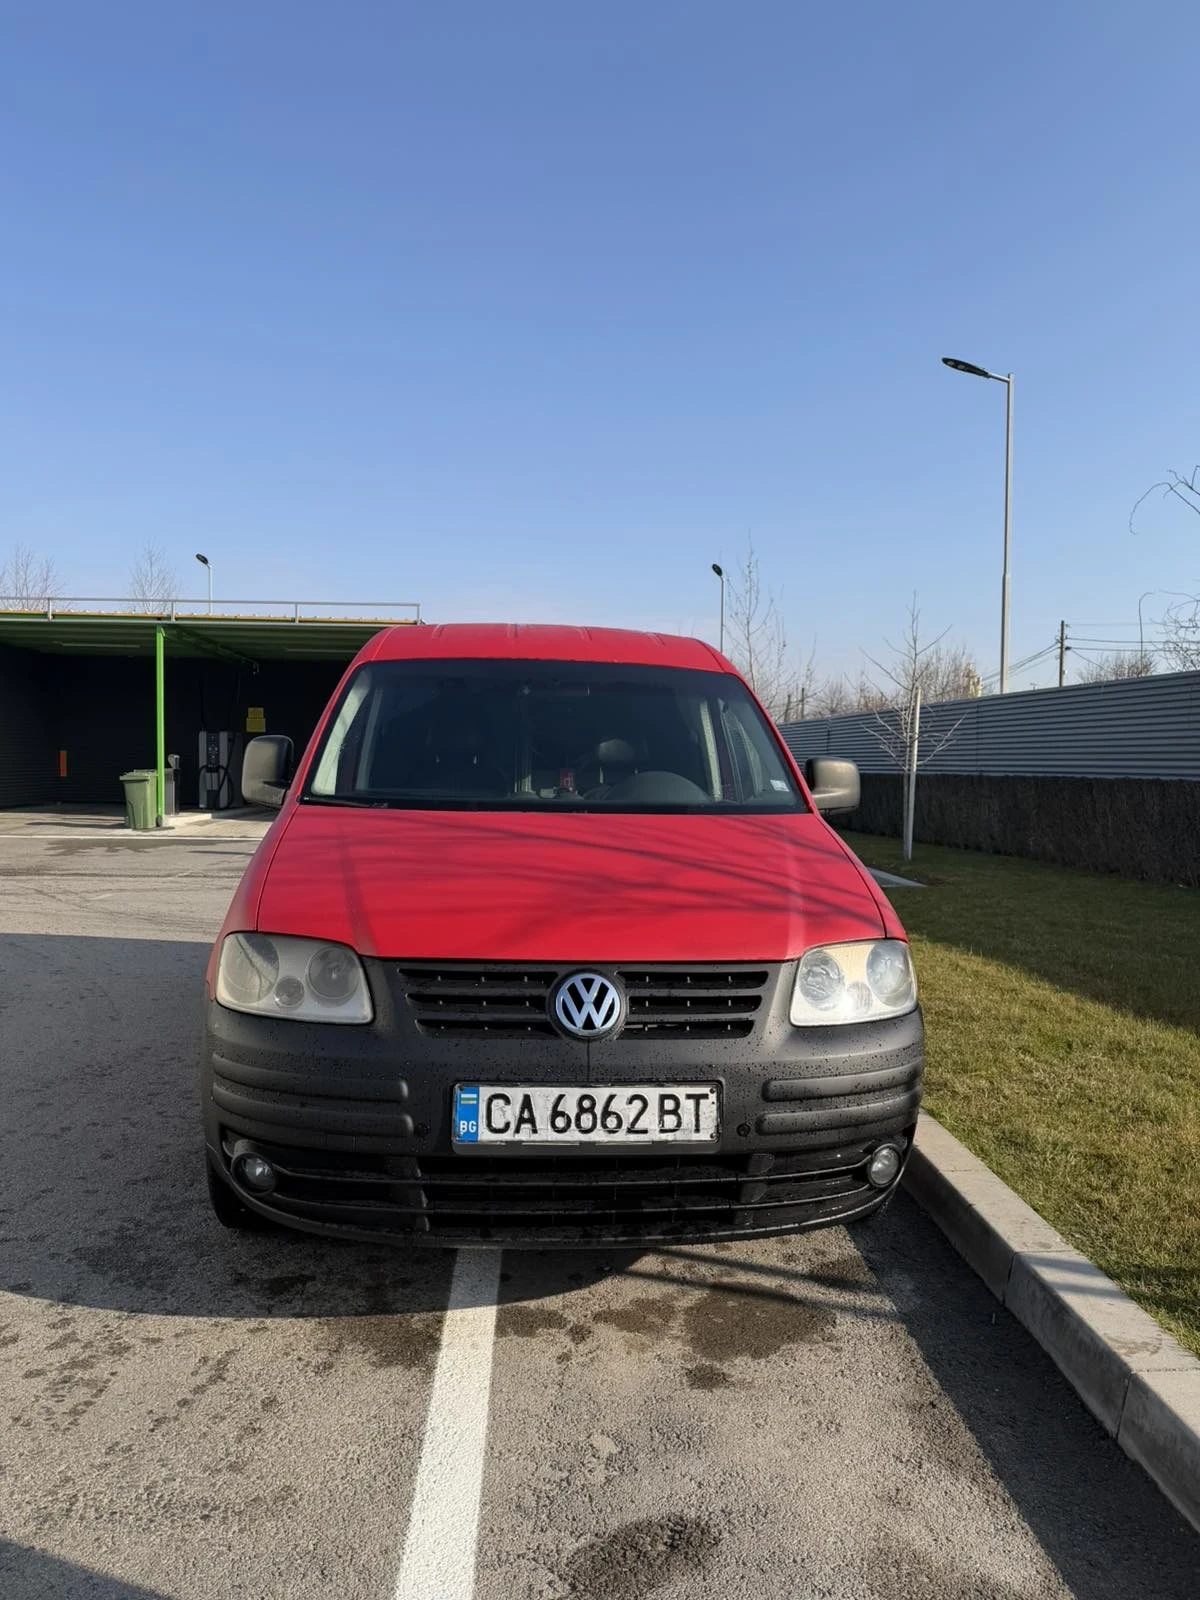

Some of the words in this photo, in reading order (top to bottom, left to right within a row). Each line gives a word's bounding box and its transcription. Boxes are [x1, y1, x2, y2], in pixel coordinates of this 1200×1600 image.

[556, 973, 620, 1036] VW
[460, 1120, 477, 1133] BG
[485, 1093, 538, 1134] CA
[550, 1093, 649, 1134] 6862
[658, 1093, 709, 1134] BT
